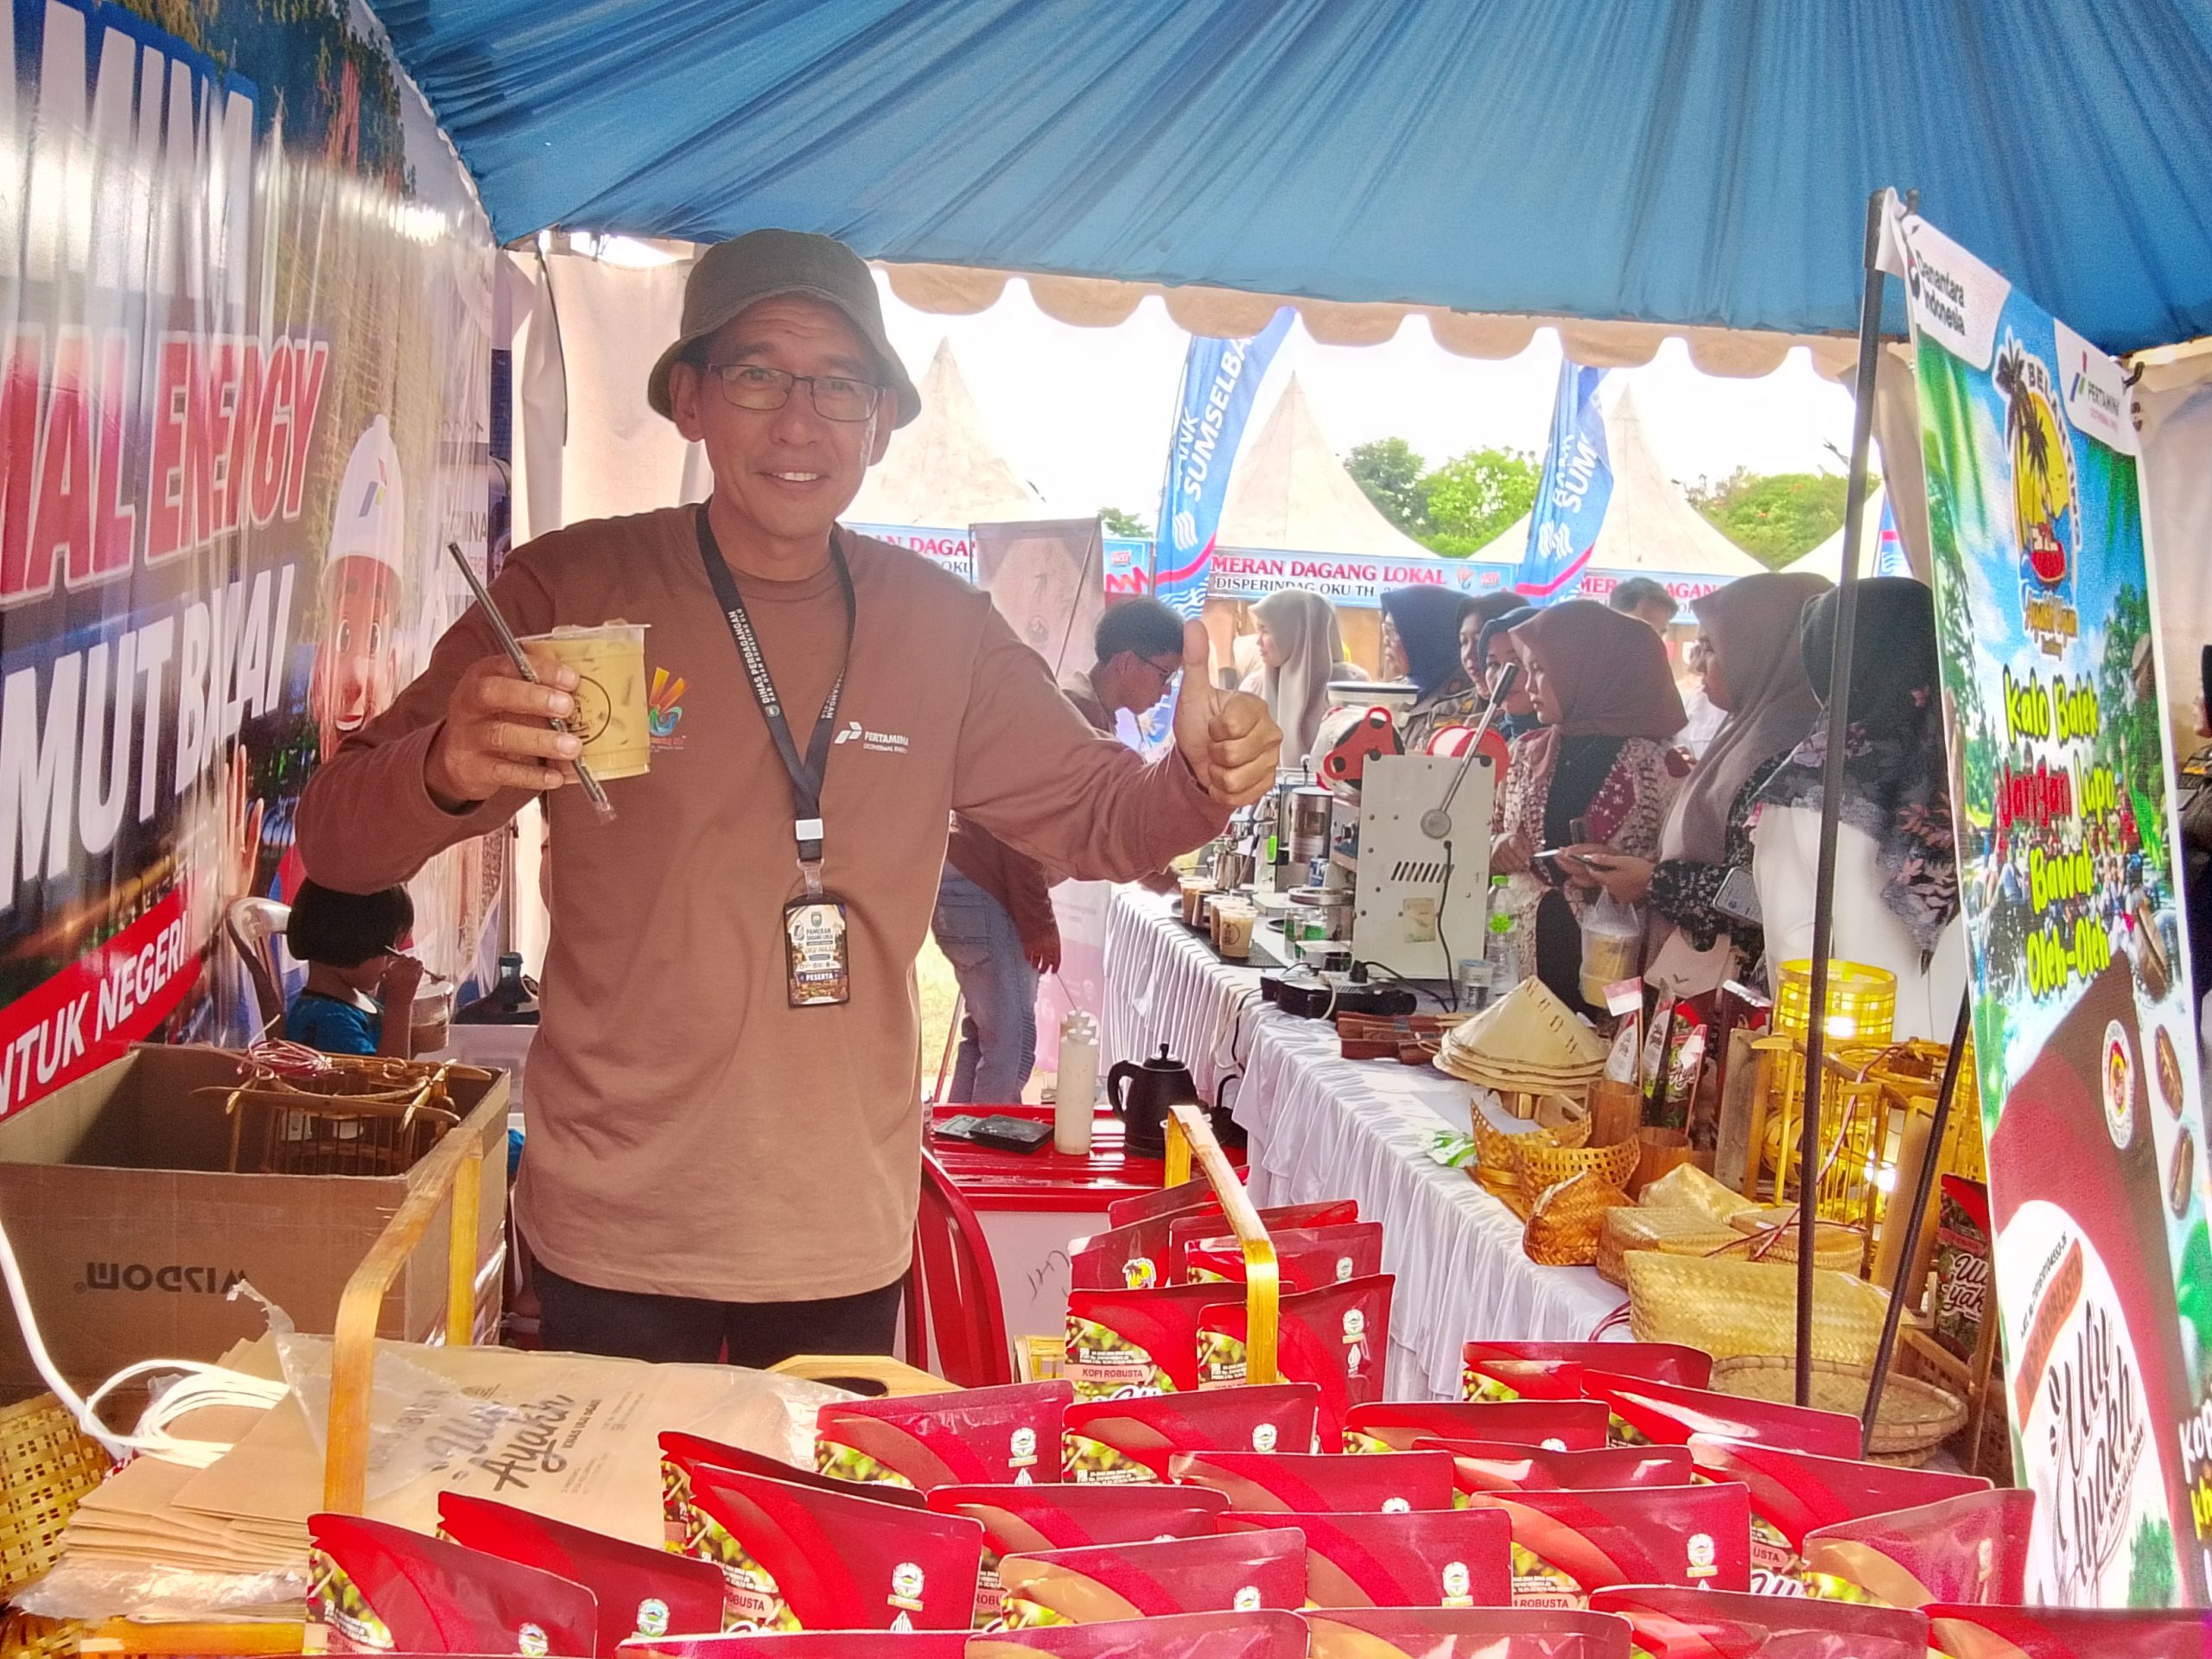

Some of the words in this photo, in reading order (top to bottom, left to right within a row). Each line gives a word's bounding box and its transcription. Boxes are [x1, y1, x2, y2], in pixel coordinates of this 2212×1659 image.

[1915, 249, 1965, 308] Danantara
[1923, 283, 1965, 336] Indonesia
[1290, 561, 1377, 582] DAGANG
[1382, 565, 1446, 585] LOKAL
[1319, 583, 1351, 595] OKU
[735, 607, 747, 623] ULU
[728, 610, 761, 677] PERDAGANGAN
[753, 675, 771, 704] DINAS
[758, 663, 770, 683] OGAN
[2004, 666, 2050, 744] Kalo
[2053, 672, 2101, 745] Balek
[864, 730, 909, 747] PERTAMINA
[2002, 758, 2073, 830] Jangan
[2030, 838, 2095, 914] Bawak
[95, 909, 187, 1042] NEGERI
[2026, 913, 2111, 999] Oleh-Oleh
[805, 973, 834, 982] PESERTA
[1082, 1368, 1103, 1378] KOPI
[1104, 1368, 1143, 1379] ROBUSTA
